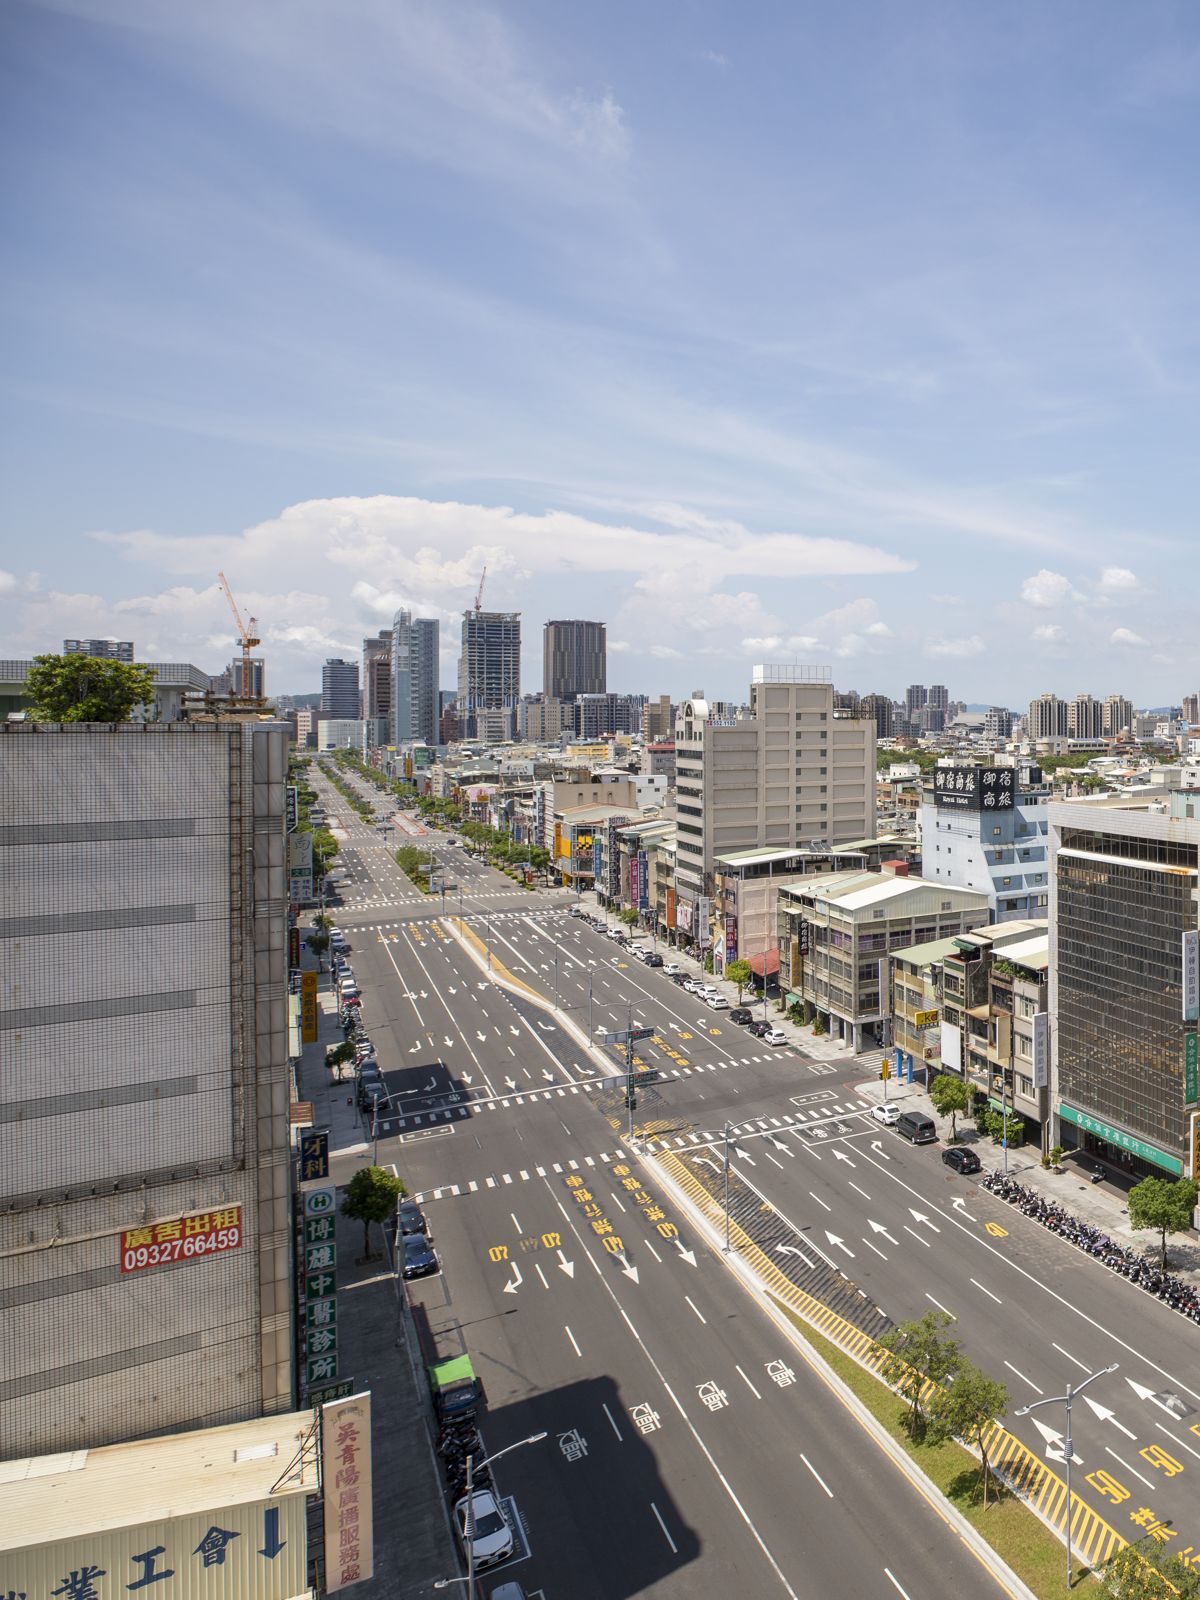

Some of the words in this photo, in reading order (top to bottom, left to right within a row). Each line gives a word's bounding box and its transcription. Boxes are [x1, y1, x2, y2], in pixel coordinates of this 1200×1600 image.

[936, 771, 975, 791] 御宿商旅
[983, 771, 1011, 786] 御宿
[984, 791, 1011, 807] 商旅
[304, 1136, 326, 1178] 牙科
[125, 1228, 239, 1269] 0932766459
[308, 1217, 336, 1382] 博雄中醫診所
[1139, 1445, 1184, 1477] 50
[335, 1422, 360, 1585] 吳青陽廣播服務處
[1085, 1469, 1131, 1504] 50
